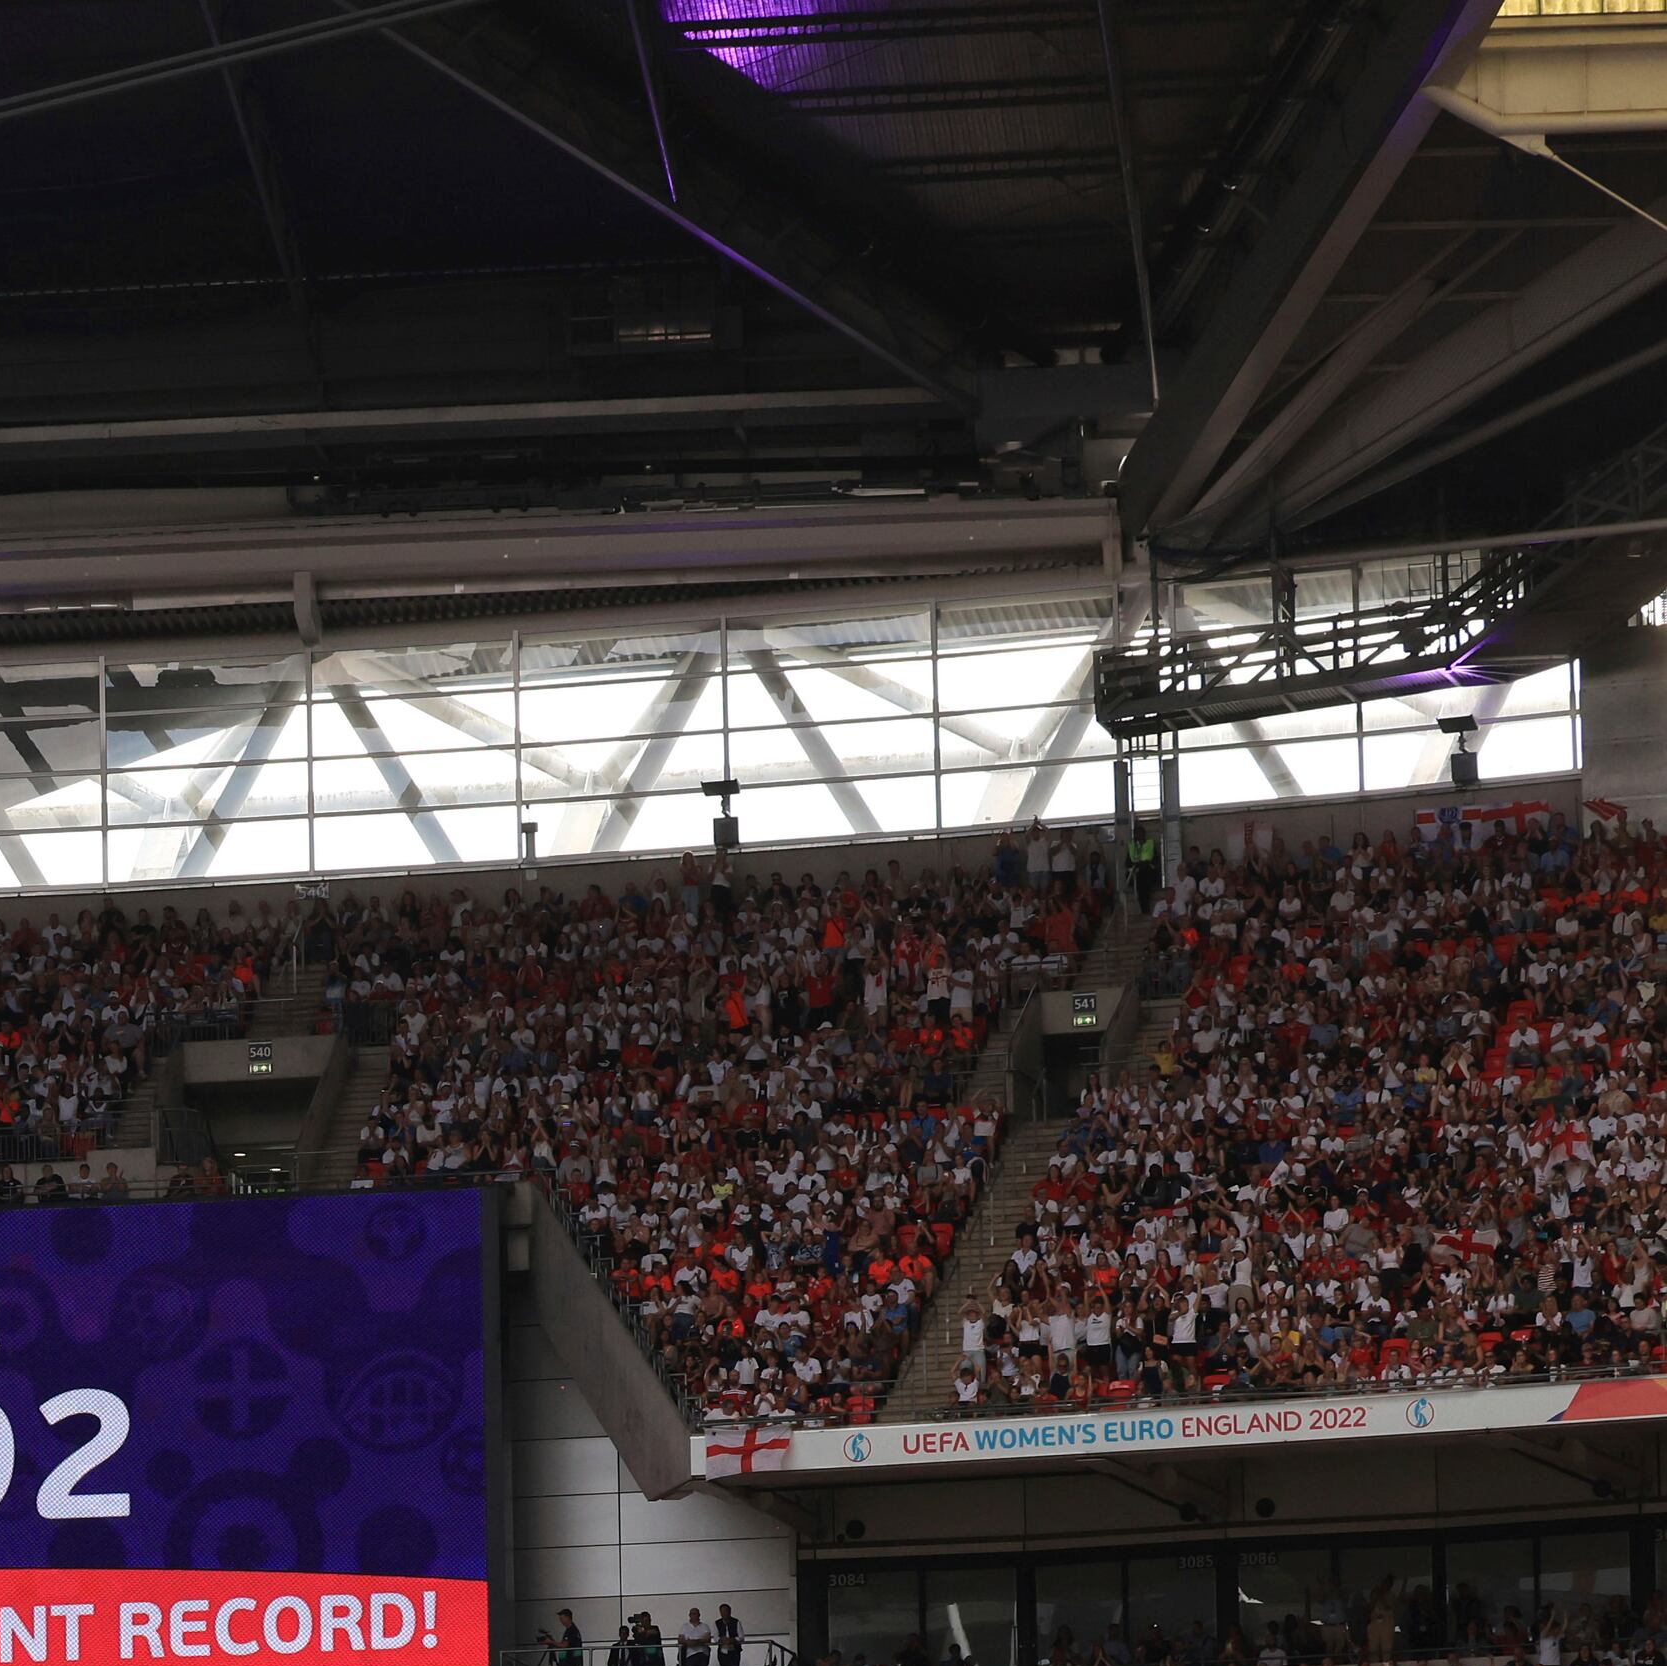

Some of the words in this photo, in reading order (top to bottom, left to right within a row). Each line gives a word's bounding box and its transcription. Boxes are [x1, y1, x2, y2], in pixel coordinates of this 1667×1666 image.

[1074, 998, 1096, 1010] 541
[249, 1046, 272, 1059] 540
[903, 1431, 969, 1455] UEFA
[975, 1424, 1097, 1450] WOMEN'S
[1104, 1419, 1173, 1442] EURO
[1182, 1412, 1302, 1438] ENGLAND
[1178, 1555, 1213, 1569] 3085
[1239, 1552, 1276, 1566] 3086
[828, 1573, 865, 1587] 3084
[117, 1589, 439, 1660] RECORD!
